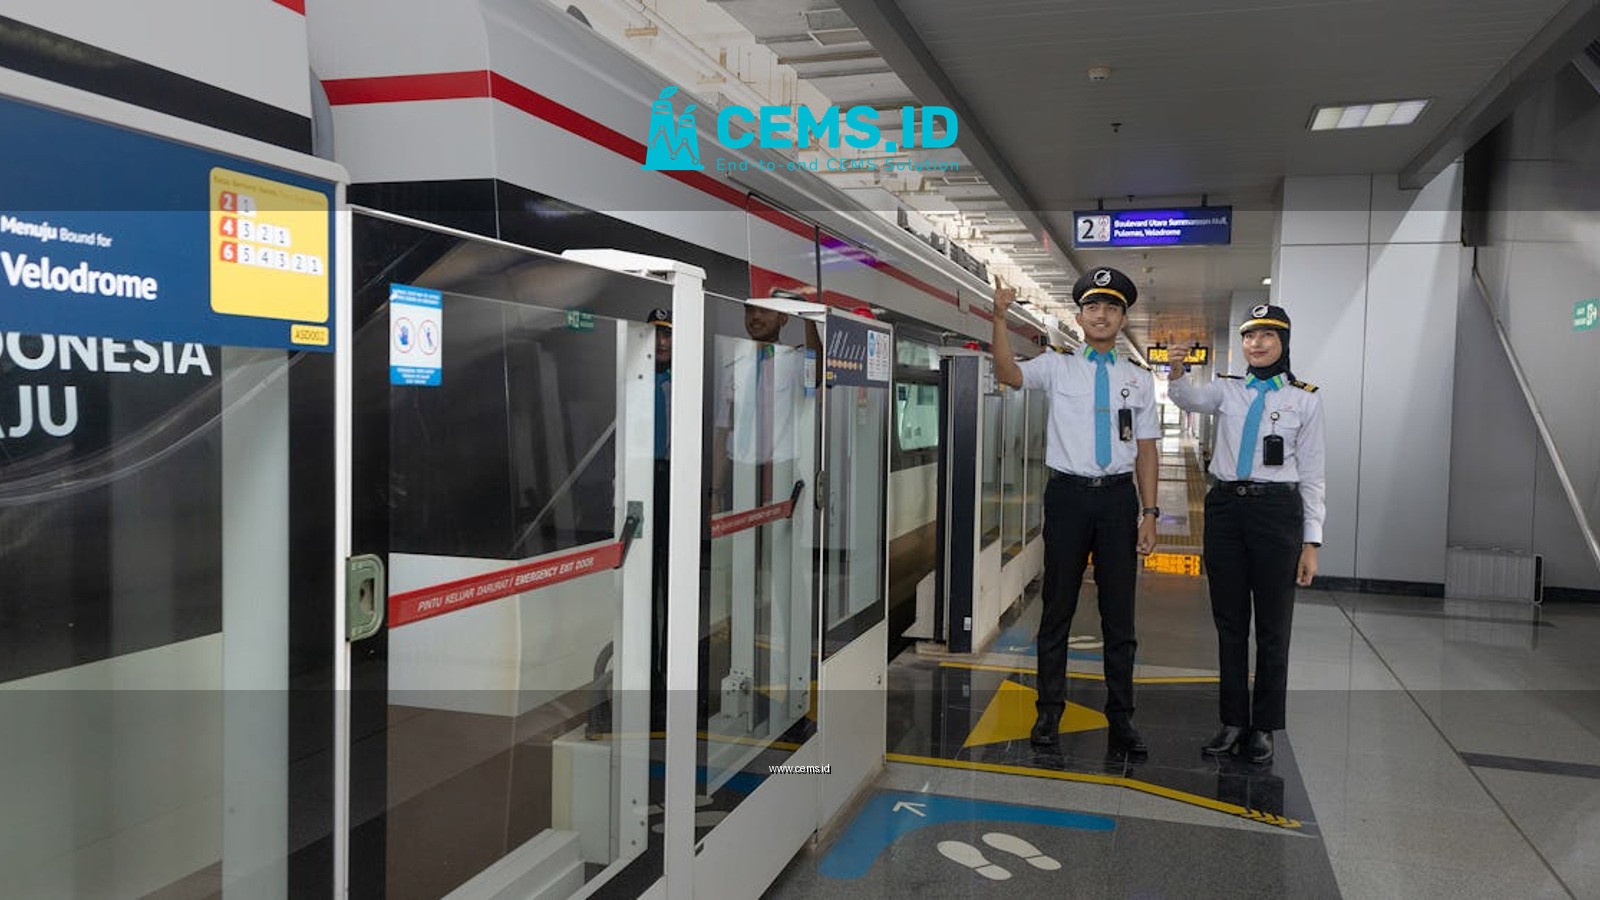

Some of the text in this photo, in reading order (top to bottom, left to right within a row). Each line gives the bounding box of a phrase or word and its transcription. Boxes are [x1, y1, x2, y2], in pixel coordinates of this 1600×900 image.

[223, 193, 233, 211] 2
[1, 214, 112, 247] Menuju Bound for
[223, 218, 234, 236] 4
[1082, 218, 1095, 239] 2
[1114, 218, 1148, 229] Boulevard
[1144, 227, 1182, 237] Velodrome
[223, 244, 234, 260] 6
[0, 251, 158, 300] Velodrome
[0, 331, 213, 376] ONESIA
[0, 384, 79, 439] JU
[417, 597, 443, 612] PINTU
[444, 588, 476, 605] KELUAR
[476, 580, 508, 597] DARURAT
[515, 567, 558, 587] EMERGENCY
[559, 562, 574, 574] EXIT
[575, 557, 595, 571] DOOR
